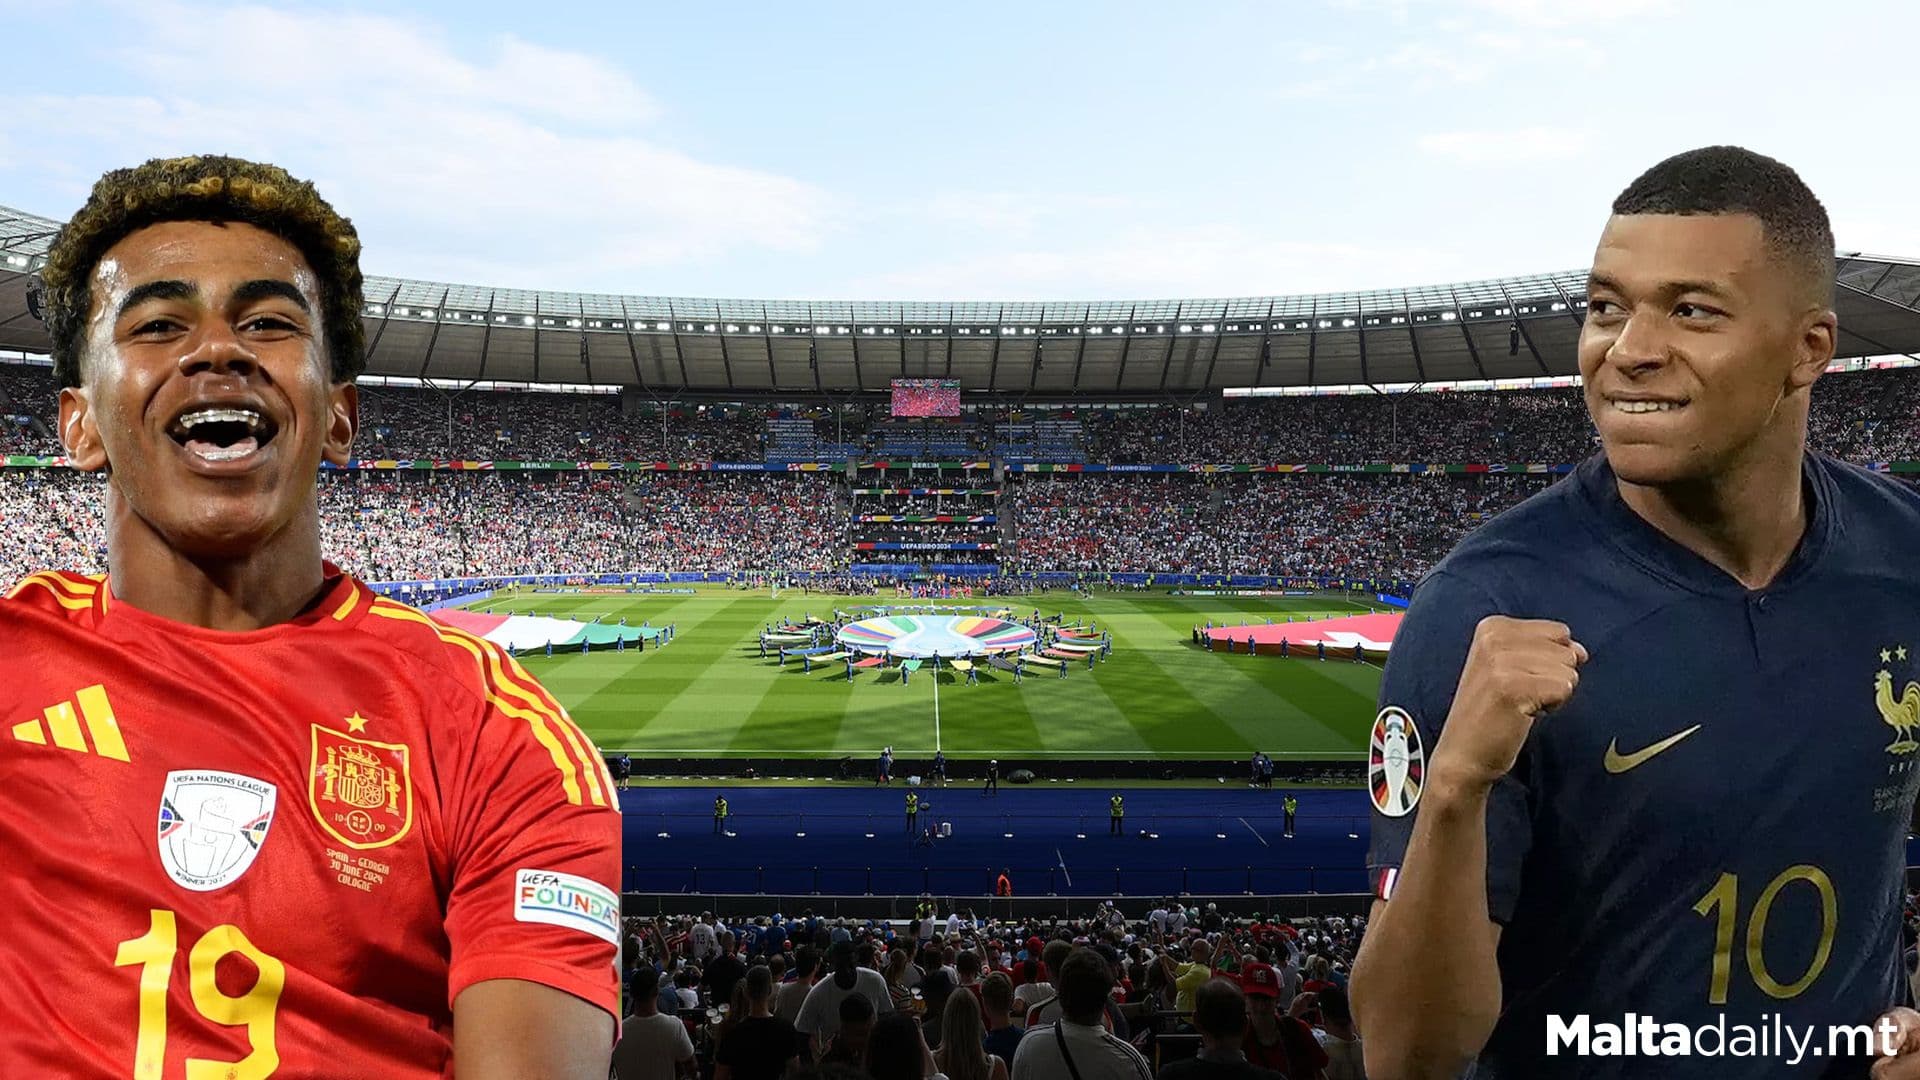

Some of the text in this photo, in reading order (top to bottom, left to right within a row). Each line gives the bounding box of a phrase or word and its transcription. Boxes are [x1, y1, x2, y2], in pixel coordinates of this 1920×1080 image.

[173, 775, 271, 795] UEFA NATIONS LEAGUE
[326, 848, 349, 863] SPAIN
[358, 857, 390, 875] GEORGIA
[337, 873, 373, 892] COLOGNE
[341, 863, 363, 878] JUNE
[363, 870, 383, 885] 2024
[521, 872, 560, 887] UEFA
[1691, 863, 1839, 1005] 10
[114, 908, 286, 1080] 19
